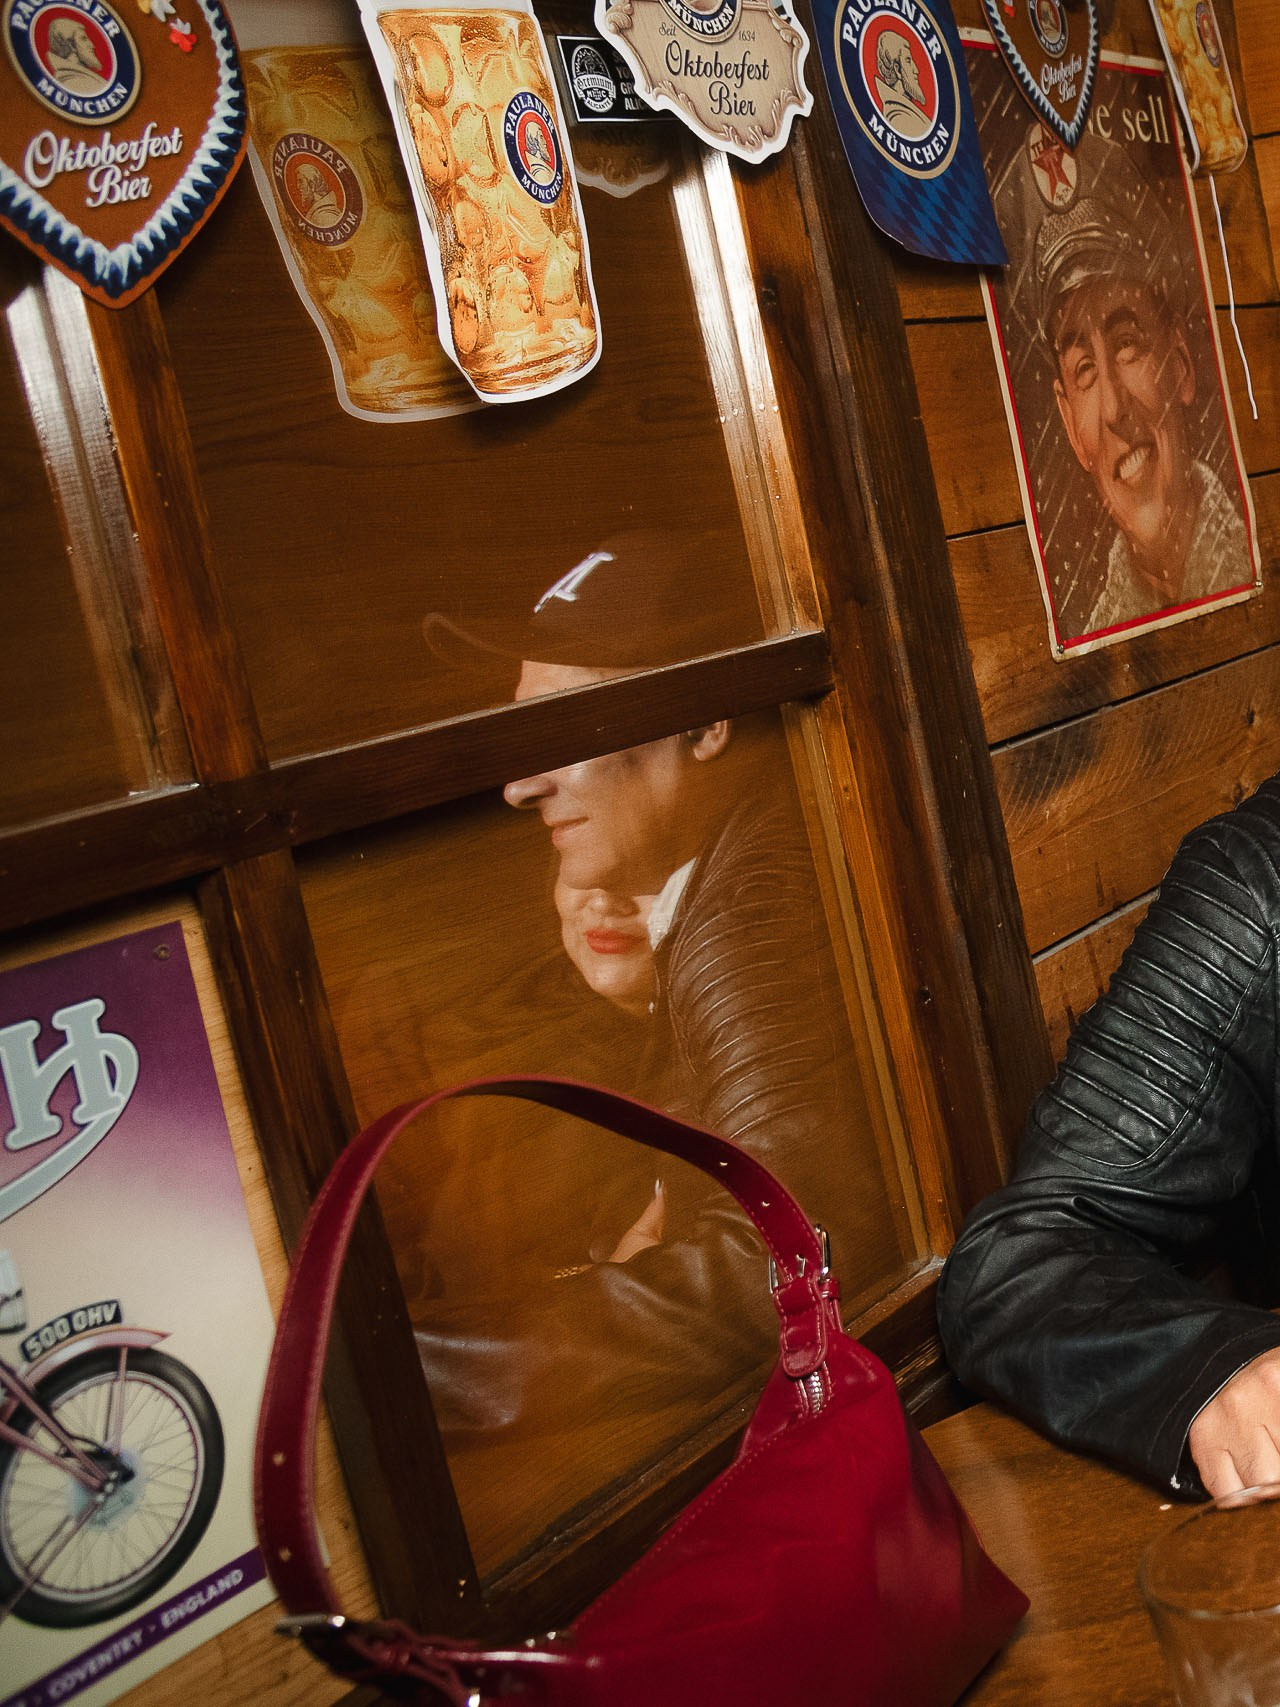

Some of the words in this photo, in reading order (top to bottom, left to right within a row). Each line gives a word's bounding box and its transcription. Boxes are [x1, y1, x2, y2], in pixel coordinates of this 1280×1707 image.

[665, 40, 769, 88] Oktoberfest
[506, 94, 555, 136] PAULANER
[708, 81, 756, 116] Bier
[1087, 103, 1113, 140] e
[1122, 95, 1171, 144] sell
[24, 122, 183, 188] Oktoberfest
[868, 114, 950, 165] MÜNCHEN
[86, 166, 151, 208] Bier
[521, 172, 562, 200] MÜNCHEN
[25, 1317, 71, 1357] 500
[72, 1303, 117, 1332] OHV
[49, 1631, 143, 1699] COVENTRY
[160, 1569, 244, 1628] ENGLAND
